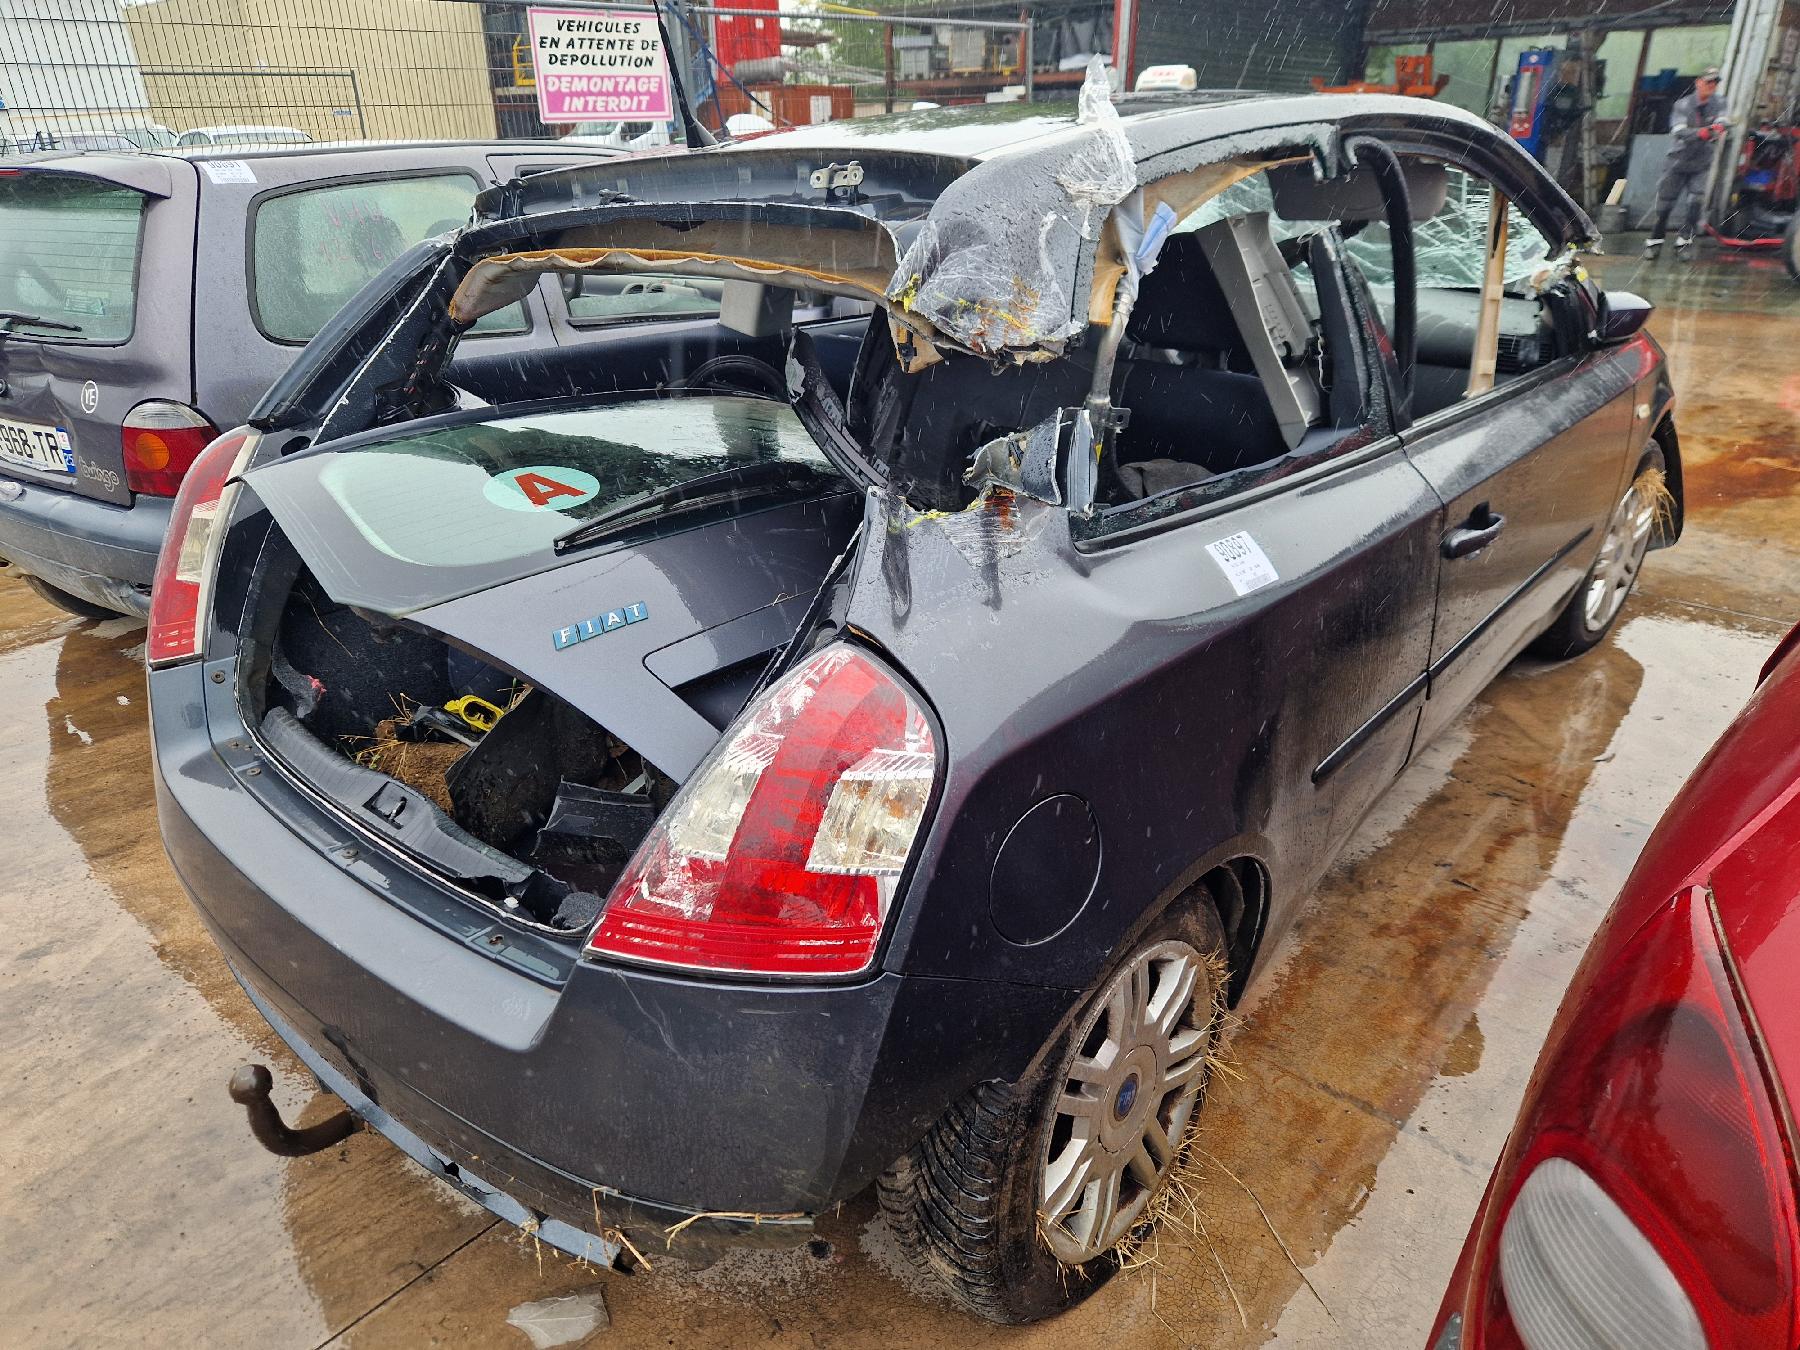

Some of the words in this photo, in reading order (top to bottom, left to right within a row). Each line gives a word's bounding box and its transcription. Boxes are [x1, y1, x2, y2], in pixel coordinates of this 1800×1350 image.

[556, 19, 641, 34] VEHICULES
[539, 36, 560, 49] EN
[566, 37, 635, 51] ATTENTE
[641, 39, 660, 51] DE
[548, 53, 655, 68] DEPOLLUTION
[546, 76, 661, 92] DEMONTAGE
[562, 95, 650, 112] INTERDIT
[513, 473, 587, 508] A
[559, 603, 641, 645] FIAT
